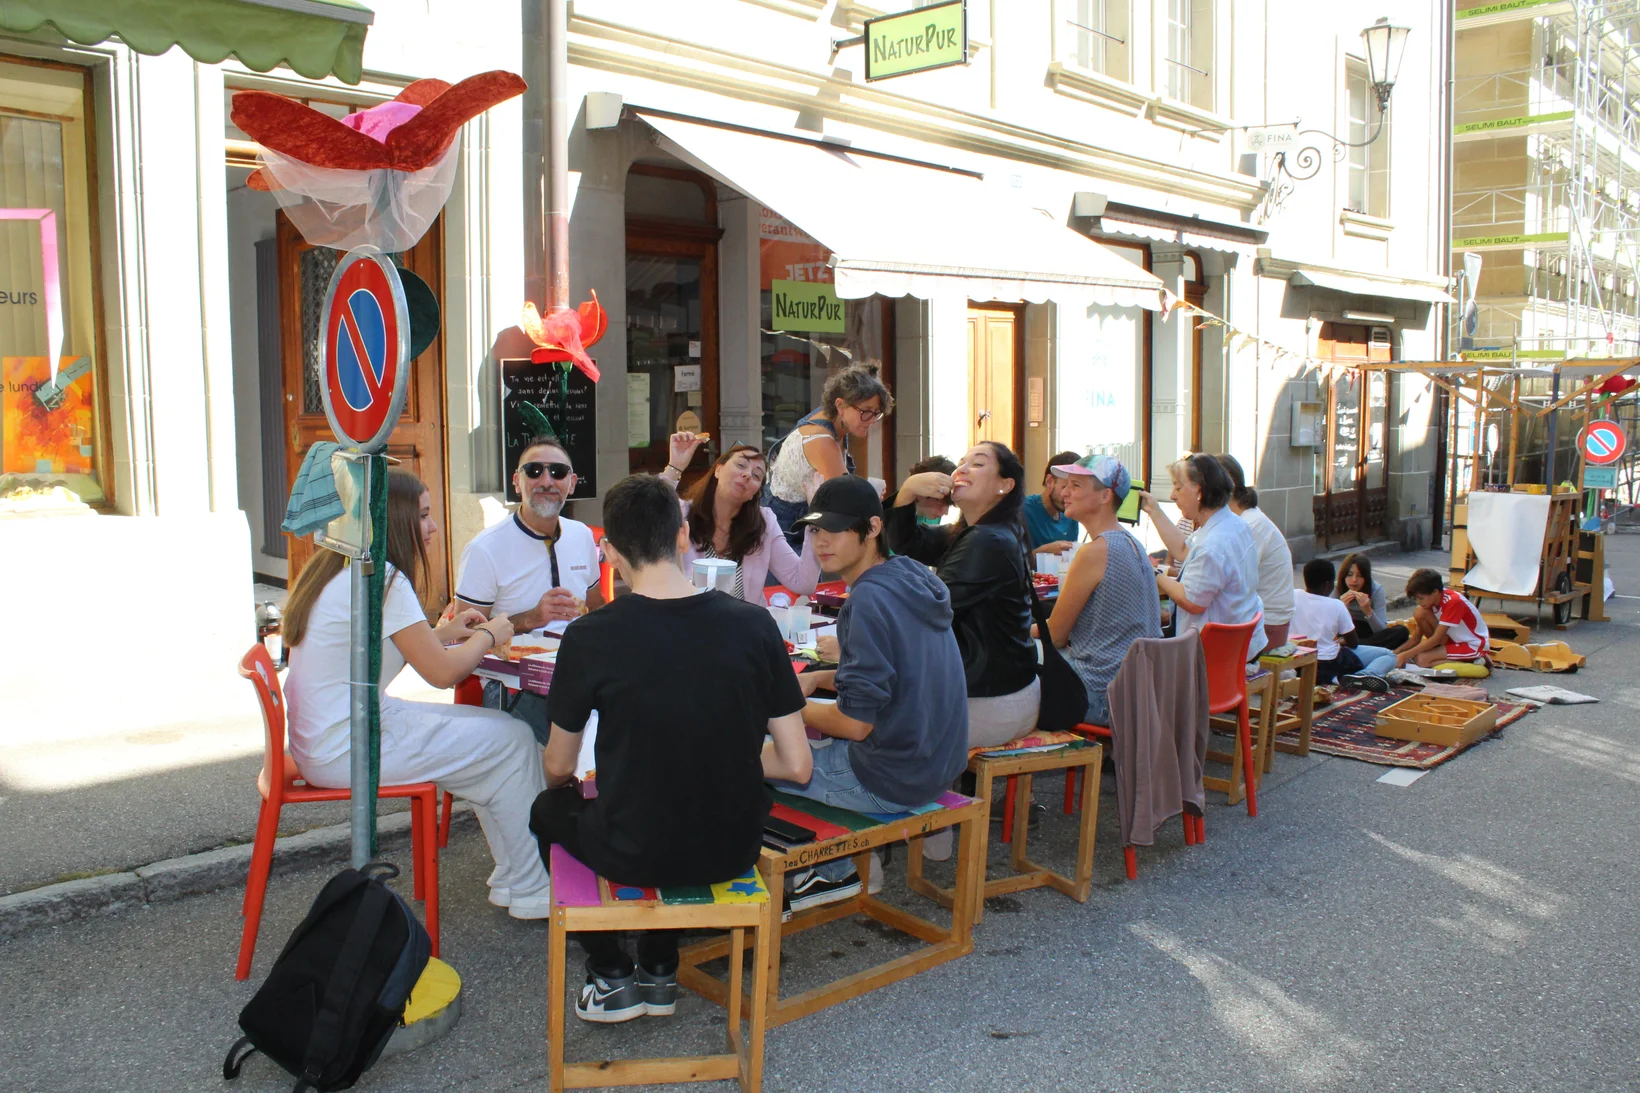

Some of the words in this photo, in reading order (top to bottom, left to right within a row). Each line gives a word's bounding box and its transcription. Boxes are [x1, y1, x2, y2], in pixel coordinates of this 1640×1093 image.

[1500, 0, 1526, 11] BAUT
[1496, 118, 1523, 127] BAUT
[1267, 134, 1292, 143] FINA
[1494, 236, 1520, 244] BAUT
[783, 856, 798, 869] les
